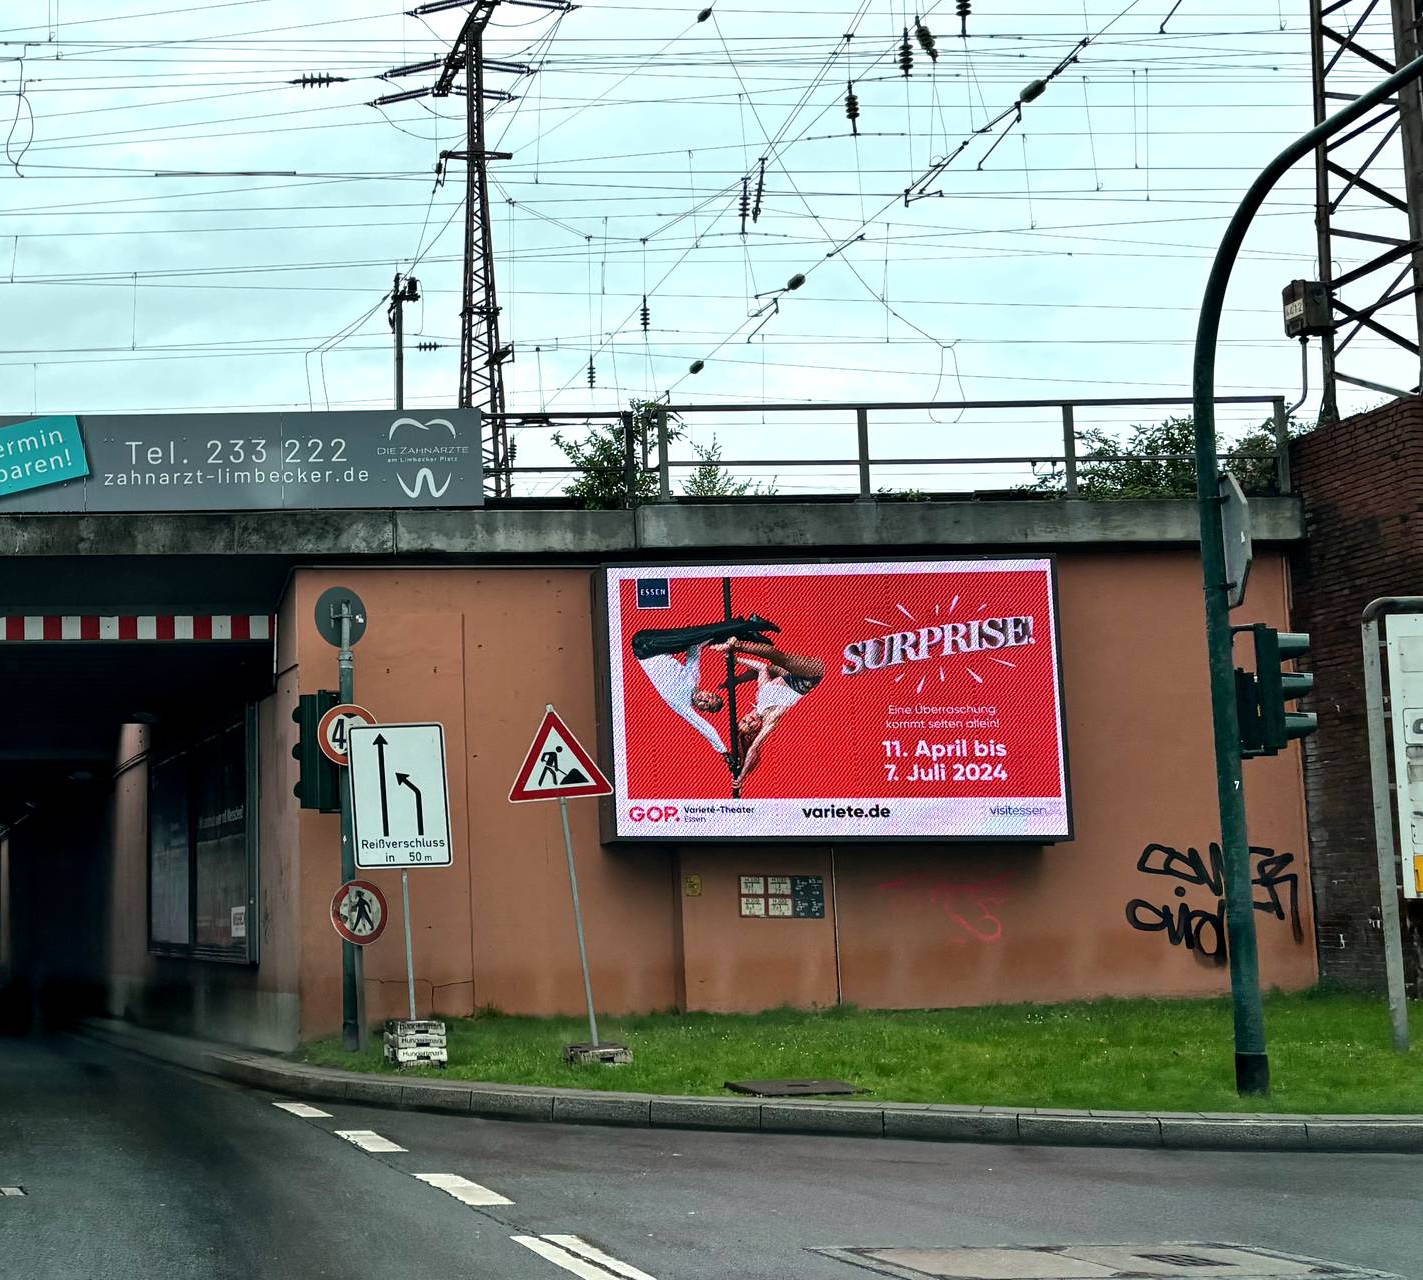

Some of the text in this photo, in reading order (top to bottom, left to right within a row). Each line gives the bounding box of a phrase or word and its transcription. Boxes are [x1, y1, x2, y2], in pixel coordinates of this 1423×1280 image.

[125, 438, 348, 465] Tel. 233 222
[376, 447, 397, 455] DIE
[104, 467, 369, 487] zahnarzt-limbecker.de
[640, 588, 666, 596] ESSEN
[841, 616, 1035, 677] SURPRISE!
[888, 703, 996, 716] Eine Überraschung
[885, 718, 999, 729] kommt selten allein!
[882, 739, 1007, 761] 11. April bis
[884, 763, 1008, 781] 7. Juli 2024
[1234, 780, 1240, 790] 7
[629, 806, 680, 822] GOP.
[802, 804, 891, 820] variete.de
[989, 805, 1047, 816] visitessen
[362, 837, 445, 849] Reißverschluss
[385, 852, 395, 862] in
[409, 851, 422, 862] 50
